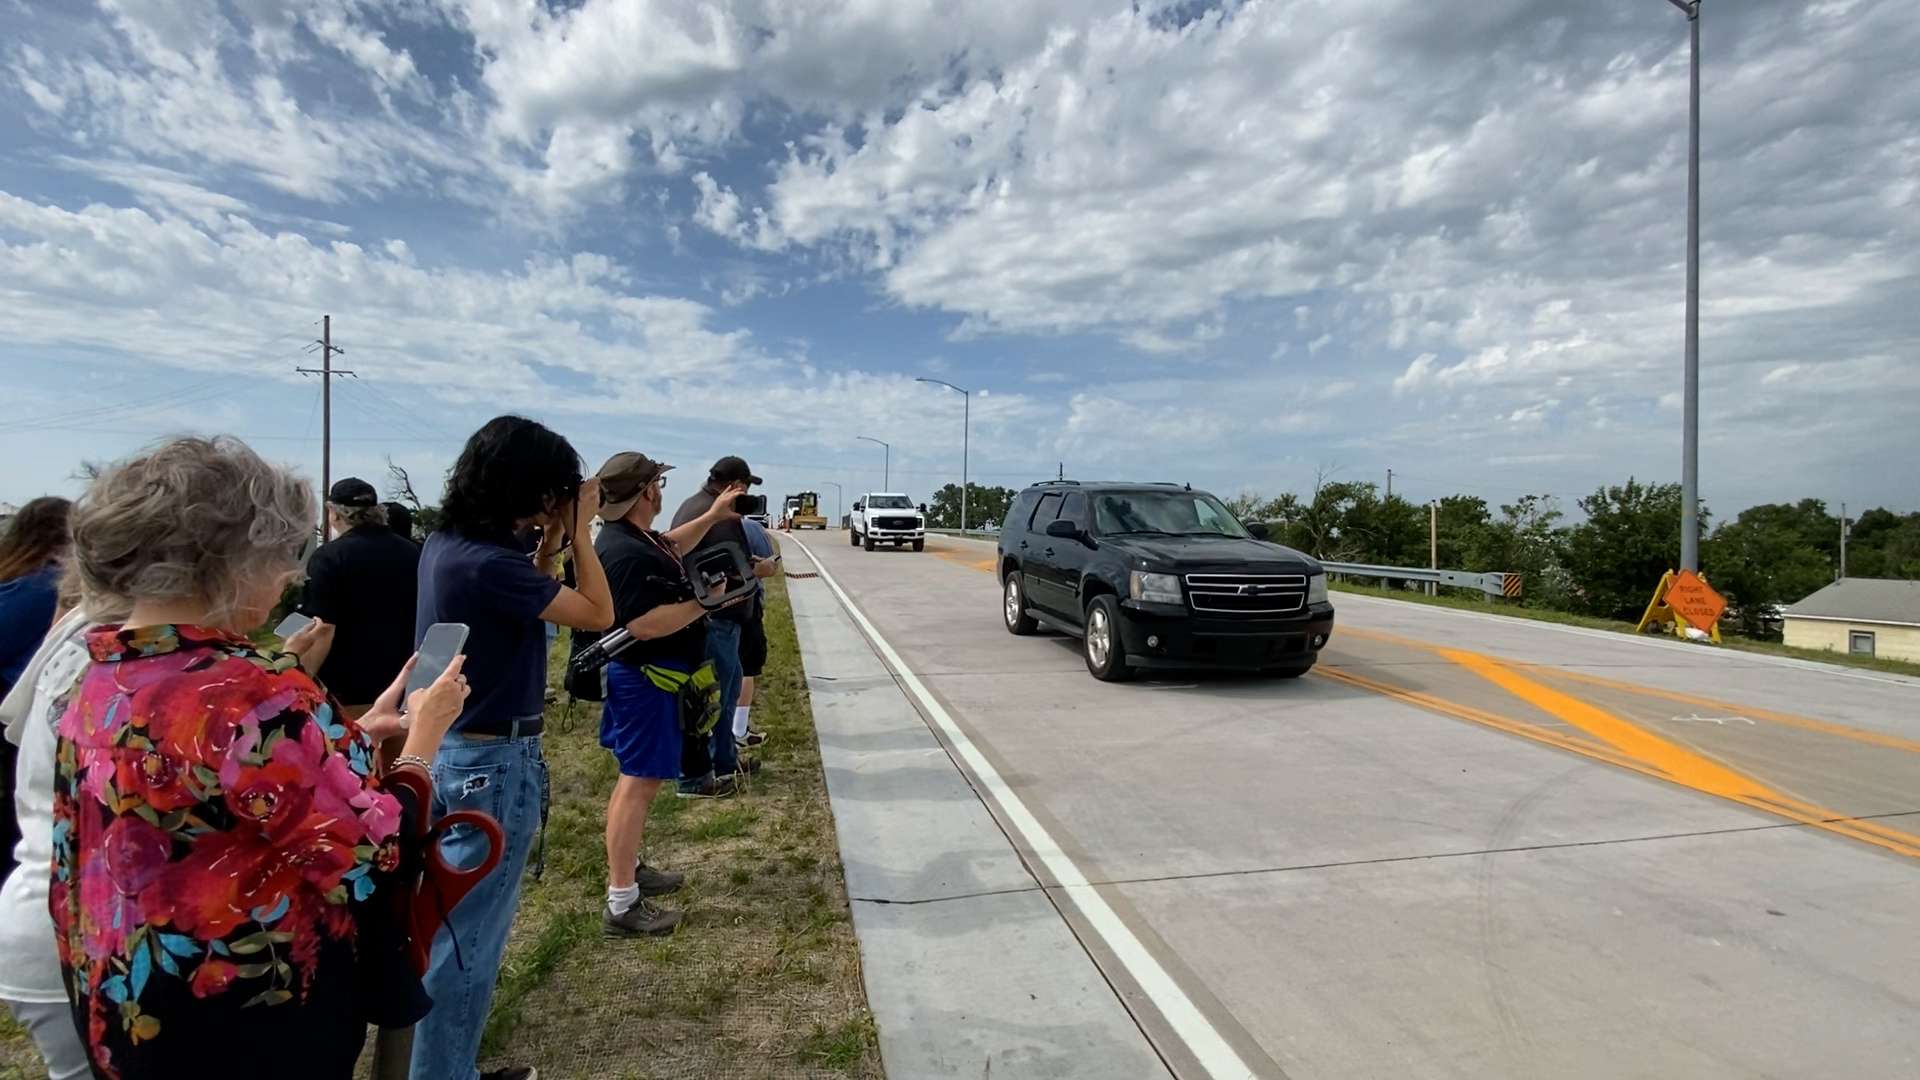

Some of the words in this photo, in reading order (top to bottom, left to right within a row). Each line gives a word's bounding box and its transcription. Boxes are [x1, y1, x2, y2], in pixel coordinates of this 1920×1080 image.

[1679, 585, 1703, 593] RIGHT
[1684, 597, 1706, 605] LANE
[1683, 607, 1715, 616] CLOSED
